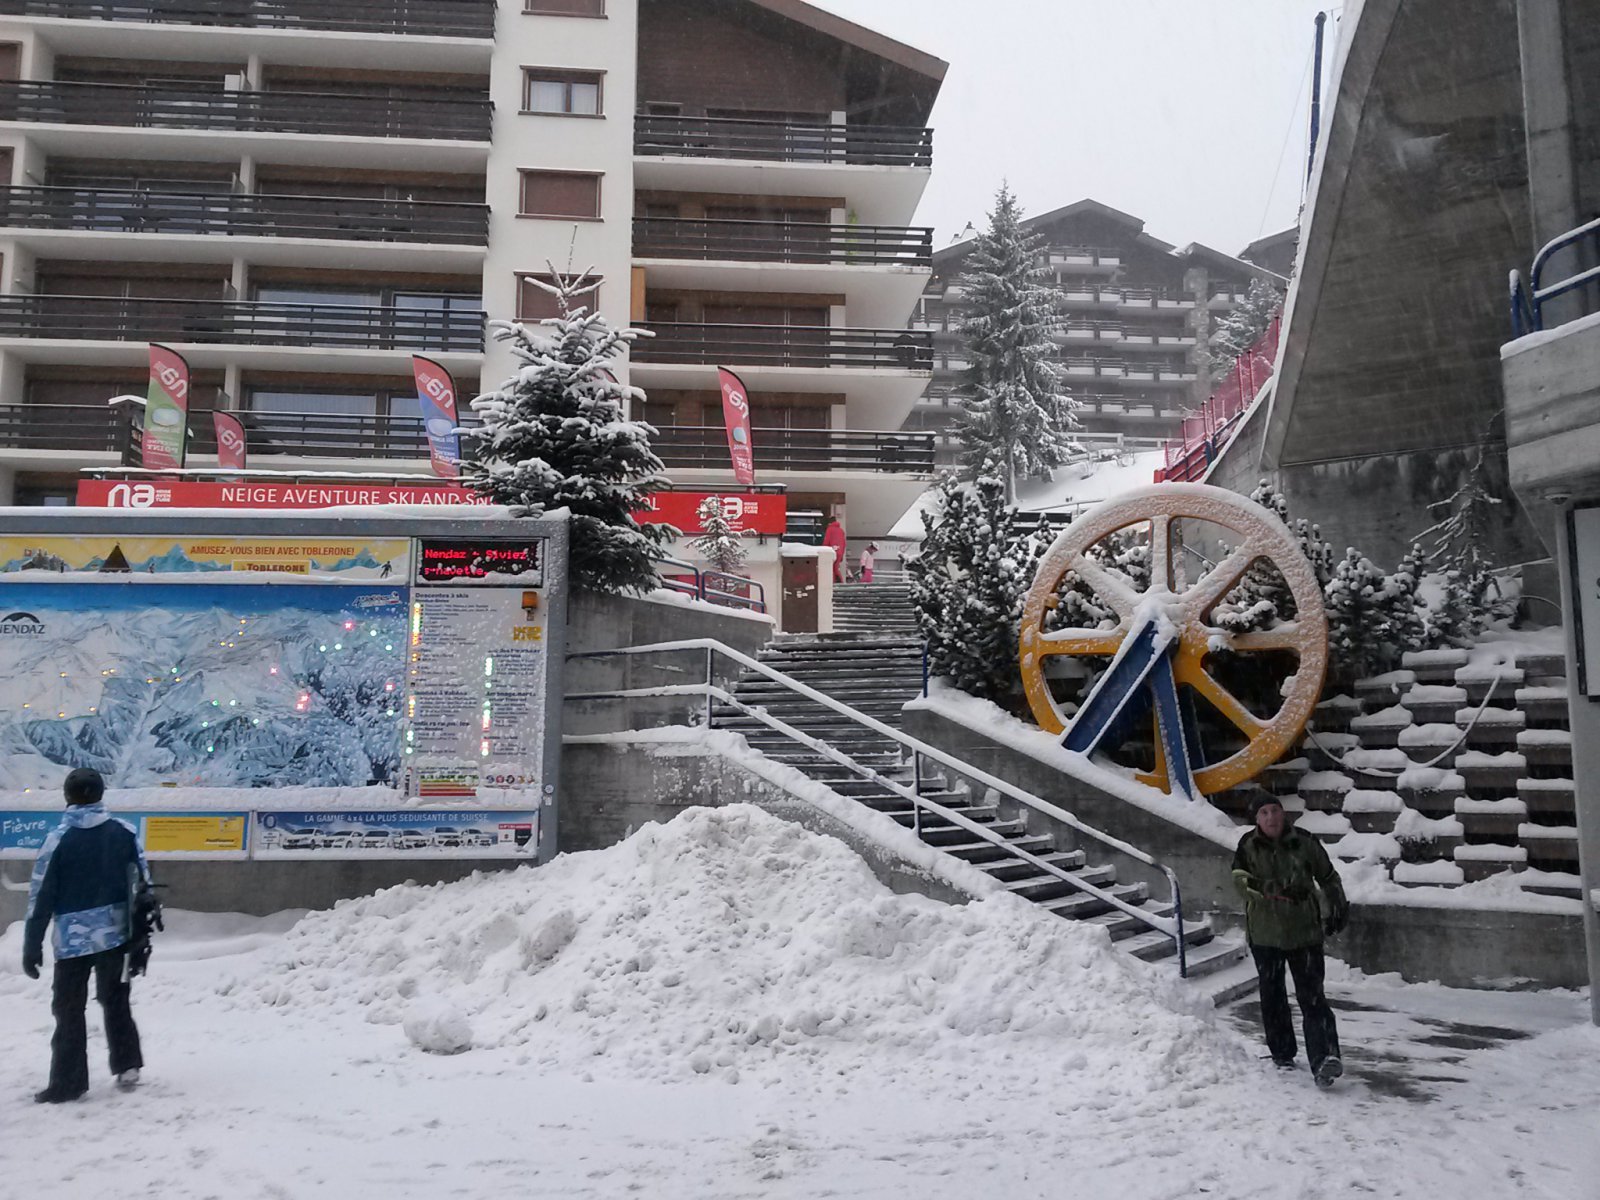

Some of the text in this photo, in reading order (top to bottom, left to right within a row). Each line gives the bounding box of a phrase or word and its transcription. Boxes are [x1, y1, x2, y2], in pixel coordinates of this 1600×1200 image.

[107, 484, 155, 508] na
[221, 487, 277, 503] NEIGE
[283, 489, 380, 505] AVENTURE
[388, 491, 415, 505] SKI
[420, 492, 459, 505] AND
[190, 546, 355, 556] AMUSEZ-VOUS BIEN AVEC TOBLERONE!
[425, 549, 466, 559] Nendaz
[486, 549, 527, 560] Siviez
[246, 563, 305, 572] TOBLERONE
[304, 814, 315, 823] LA
[316, 814, 345, 823] GAMME
[347, 814, 363, 822] 4x4
[365, 814, 375, 822] LA
[376, 813, 397, 822] PLUS
[448, 813, 459, 822] DE
[461, 813, 489, 822] SUISSE
[3, 817, 47, 835] Fièvre
